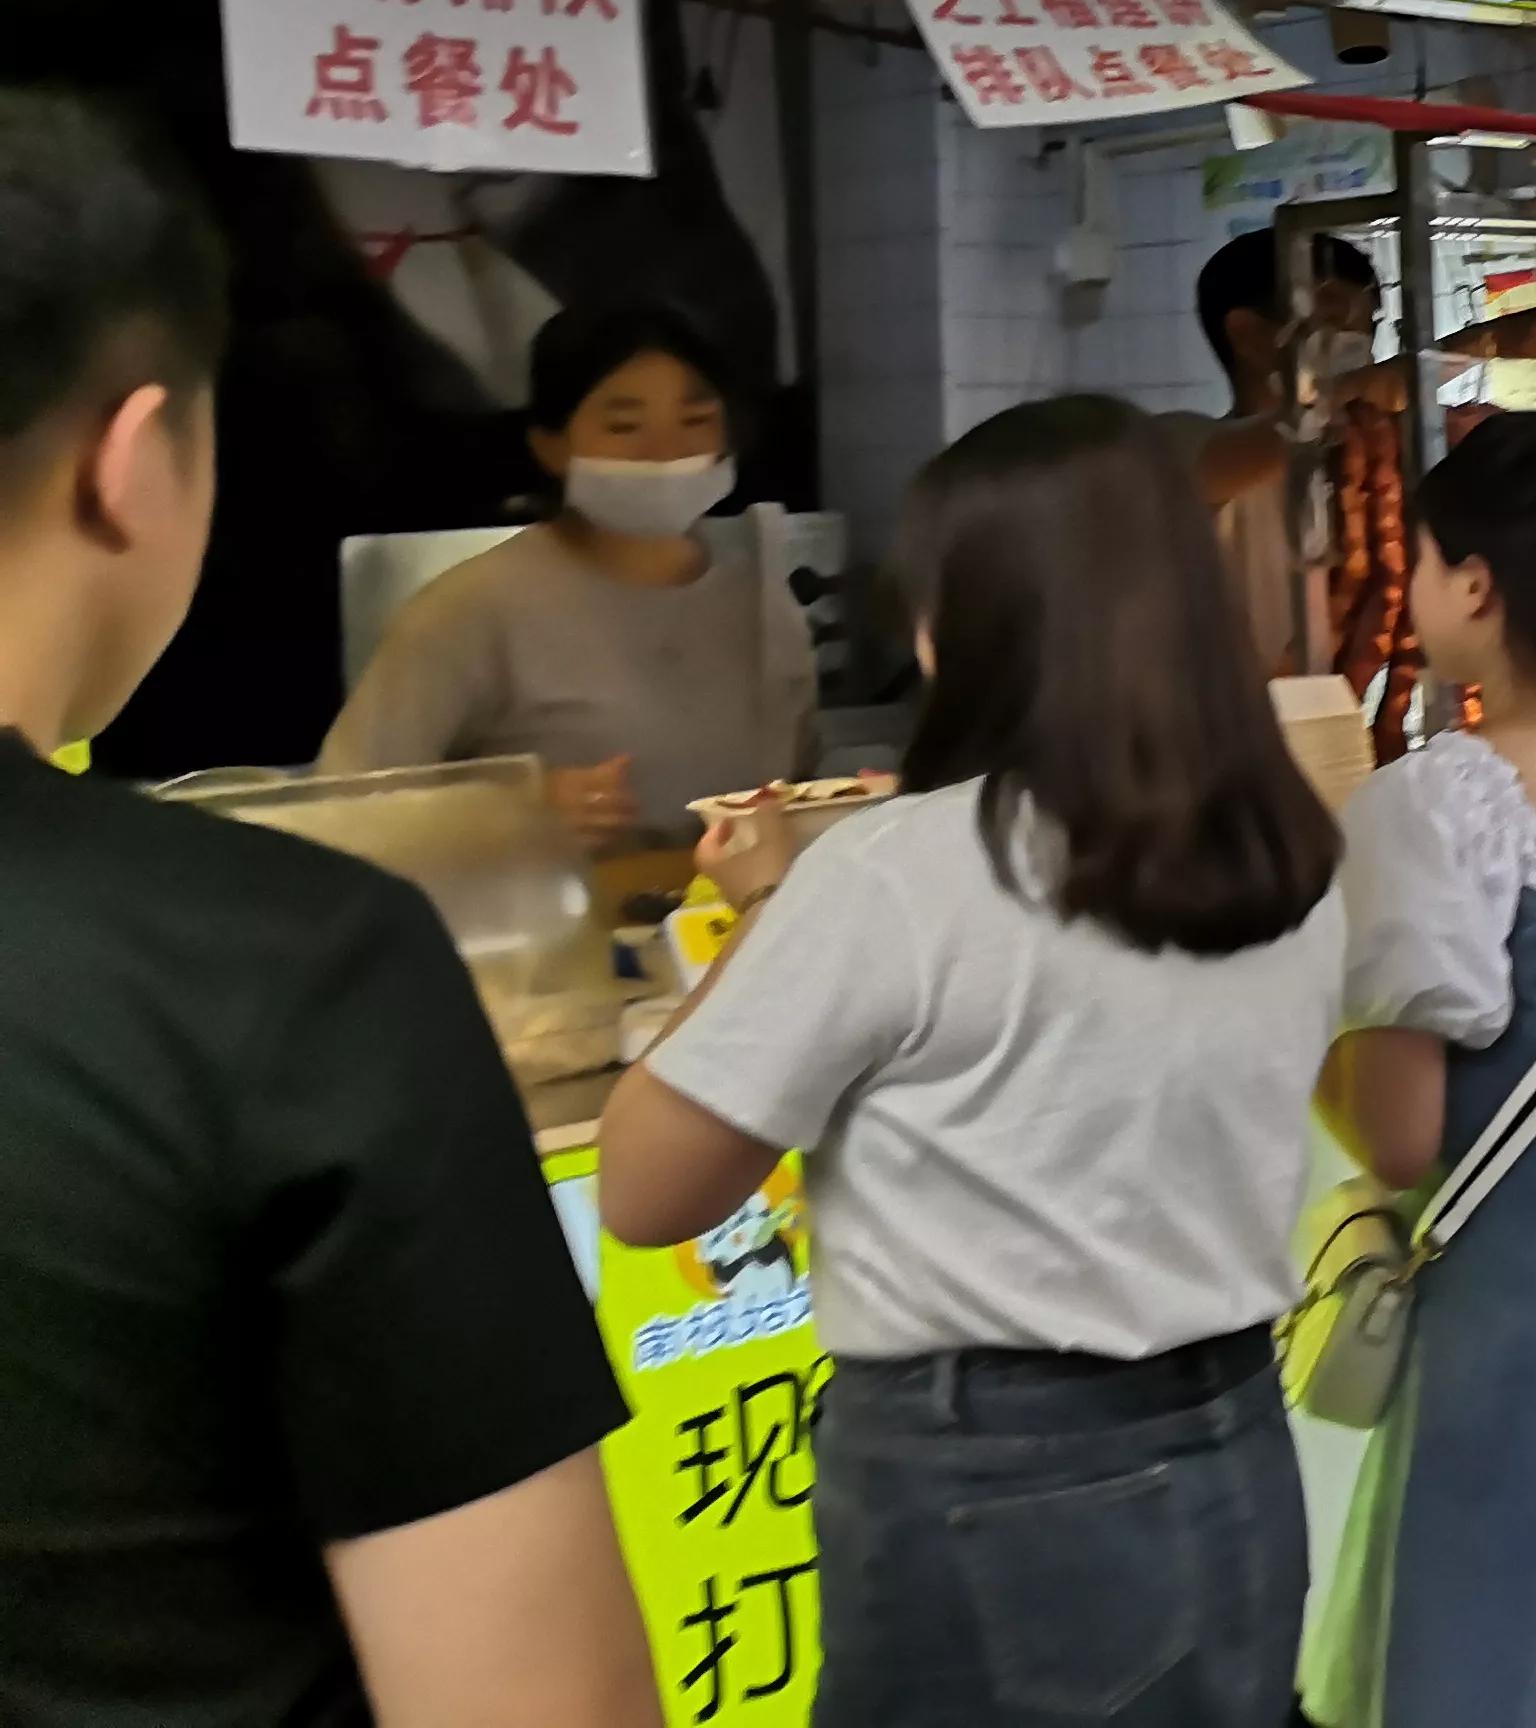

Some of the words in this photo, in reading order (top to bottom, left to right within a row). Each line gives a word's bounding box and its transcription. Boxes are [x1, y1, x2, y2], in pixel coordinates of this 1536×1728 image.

[305, 25, 580, 135] 点餐处
[952, 44, 1274, 104] 排队点餐处
